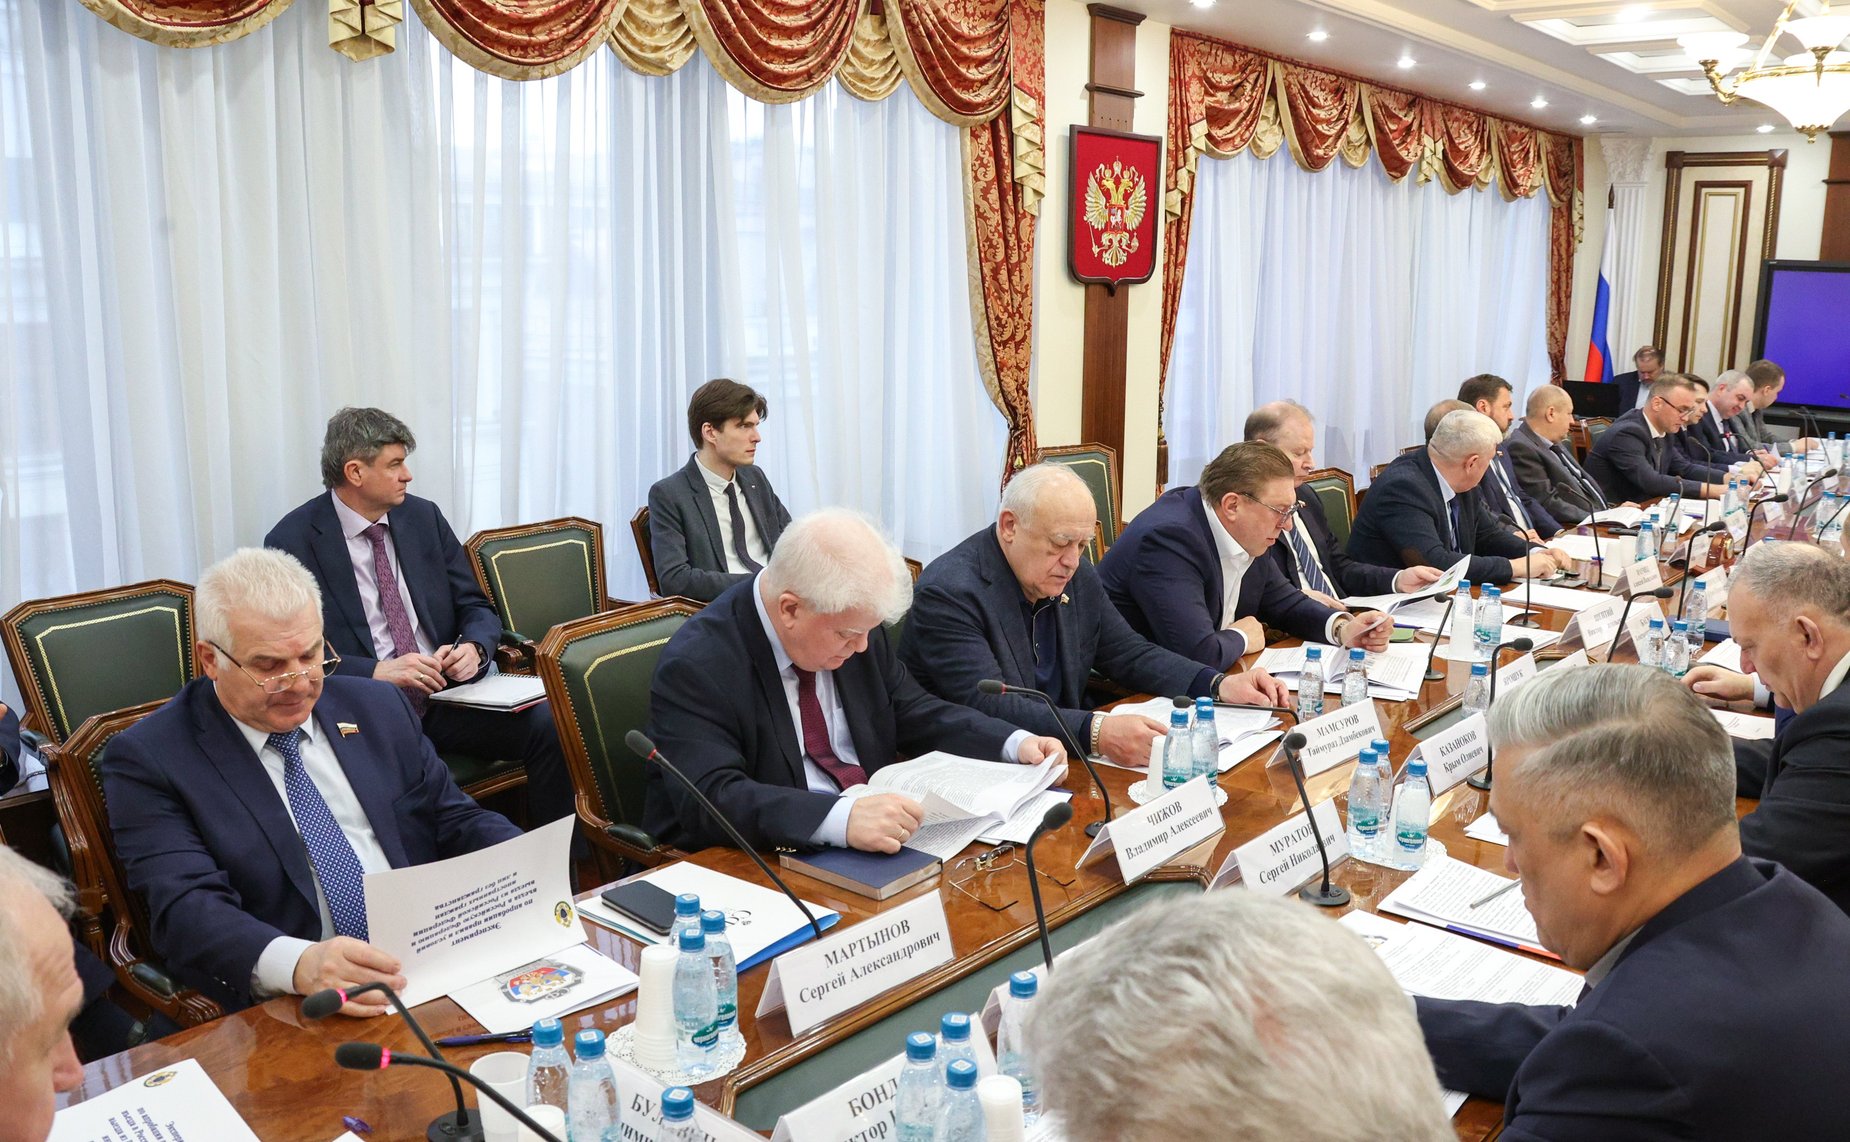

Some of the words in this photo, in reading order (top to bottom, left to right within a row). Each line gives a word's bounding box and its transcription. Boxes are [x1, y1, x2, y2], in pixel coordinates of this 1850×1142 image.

[1316, 714, 1360, 737] МАМСУРОВ
[1440, 730, 1476, 757] КАЗАНОКОВ
[1443, 758, 1461, 774] Крым
[1146, 801, 1182, 826] ЧИЖОВ
[1126, 832, 1168, 860] Владимир
[1170, 807, 1213, 837] Алексеевич
[1260, 858, 1290, 884] Сергей
[1289, 834, 1336, 867] Николавич
[451, 922, 501, 947] Эксперимент
[824, 919, 910, 968] МАРТЫНОВ
[800, 972, 846, 1003] Сергей
[850, 931, 941, 982] Александрович
[848, 1077, 898, 1118] БОНД
